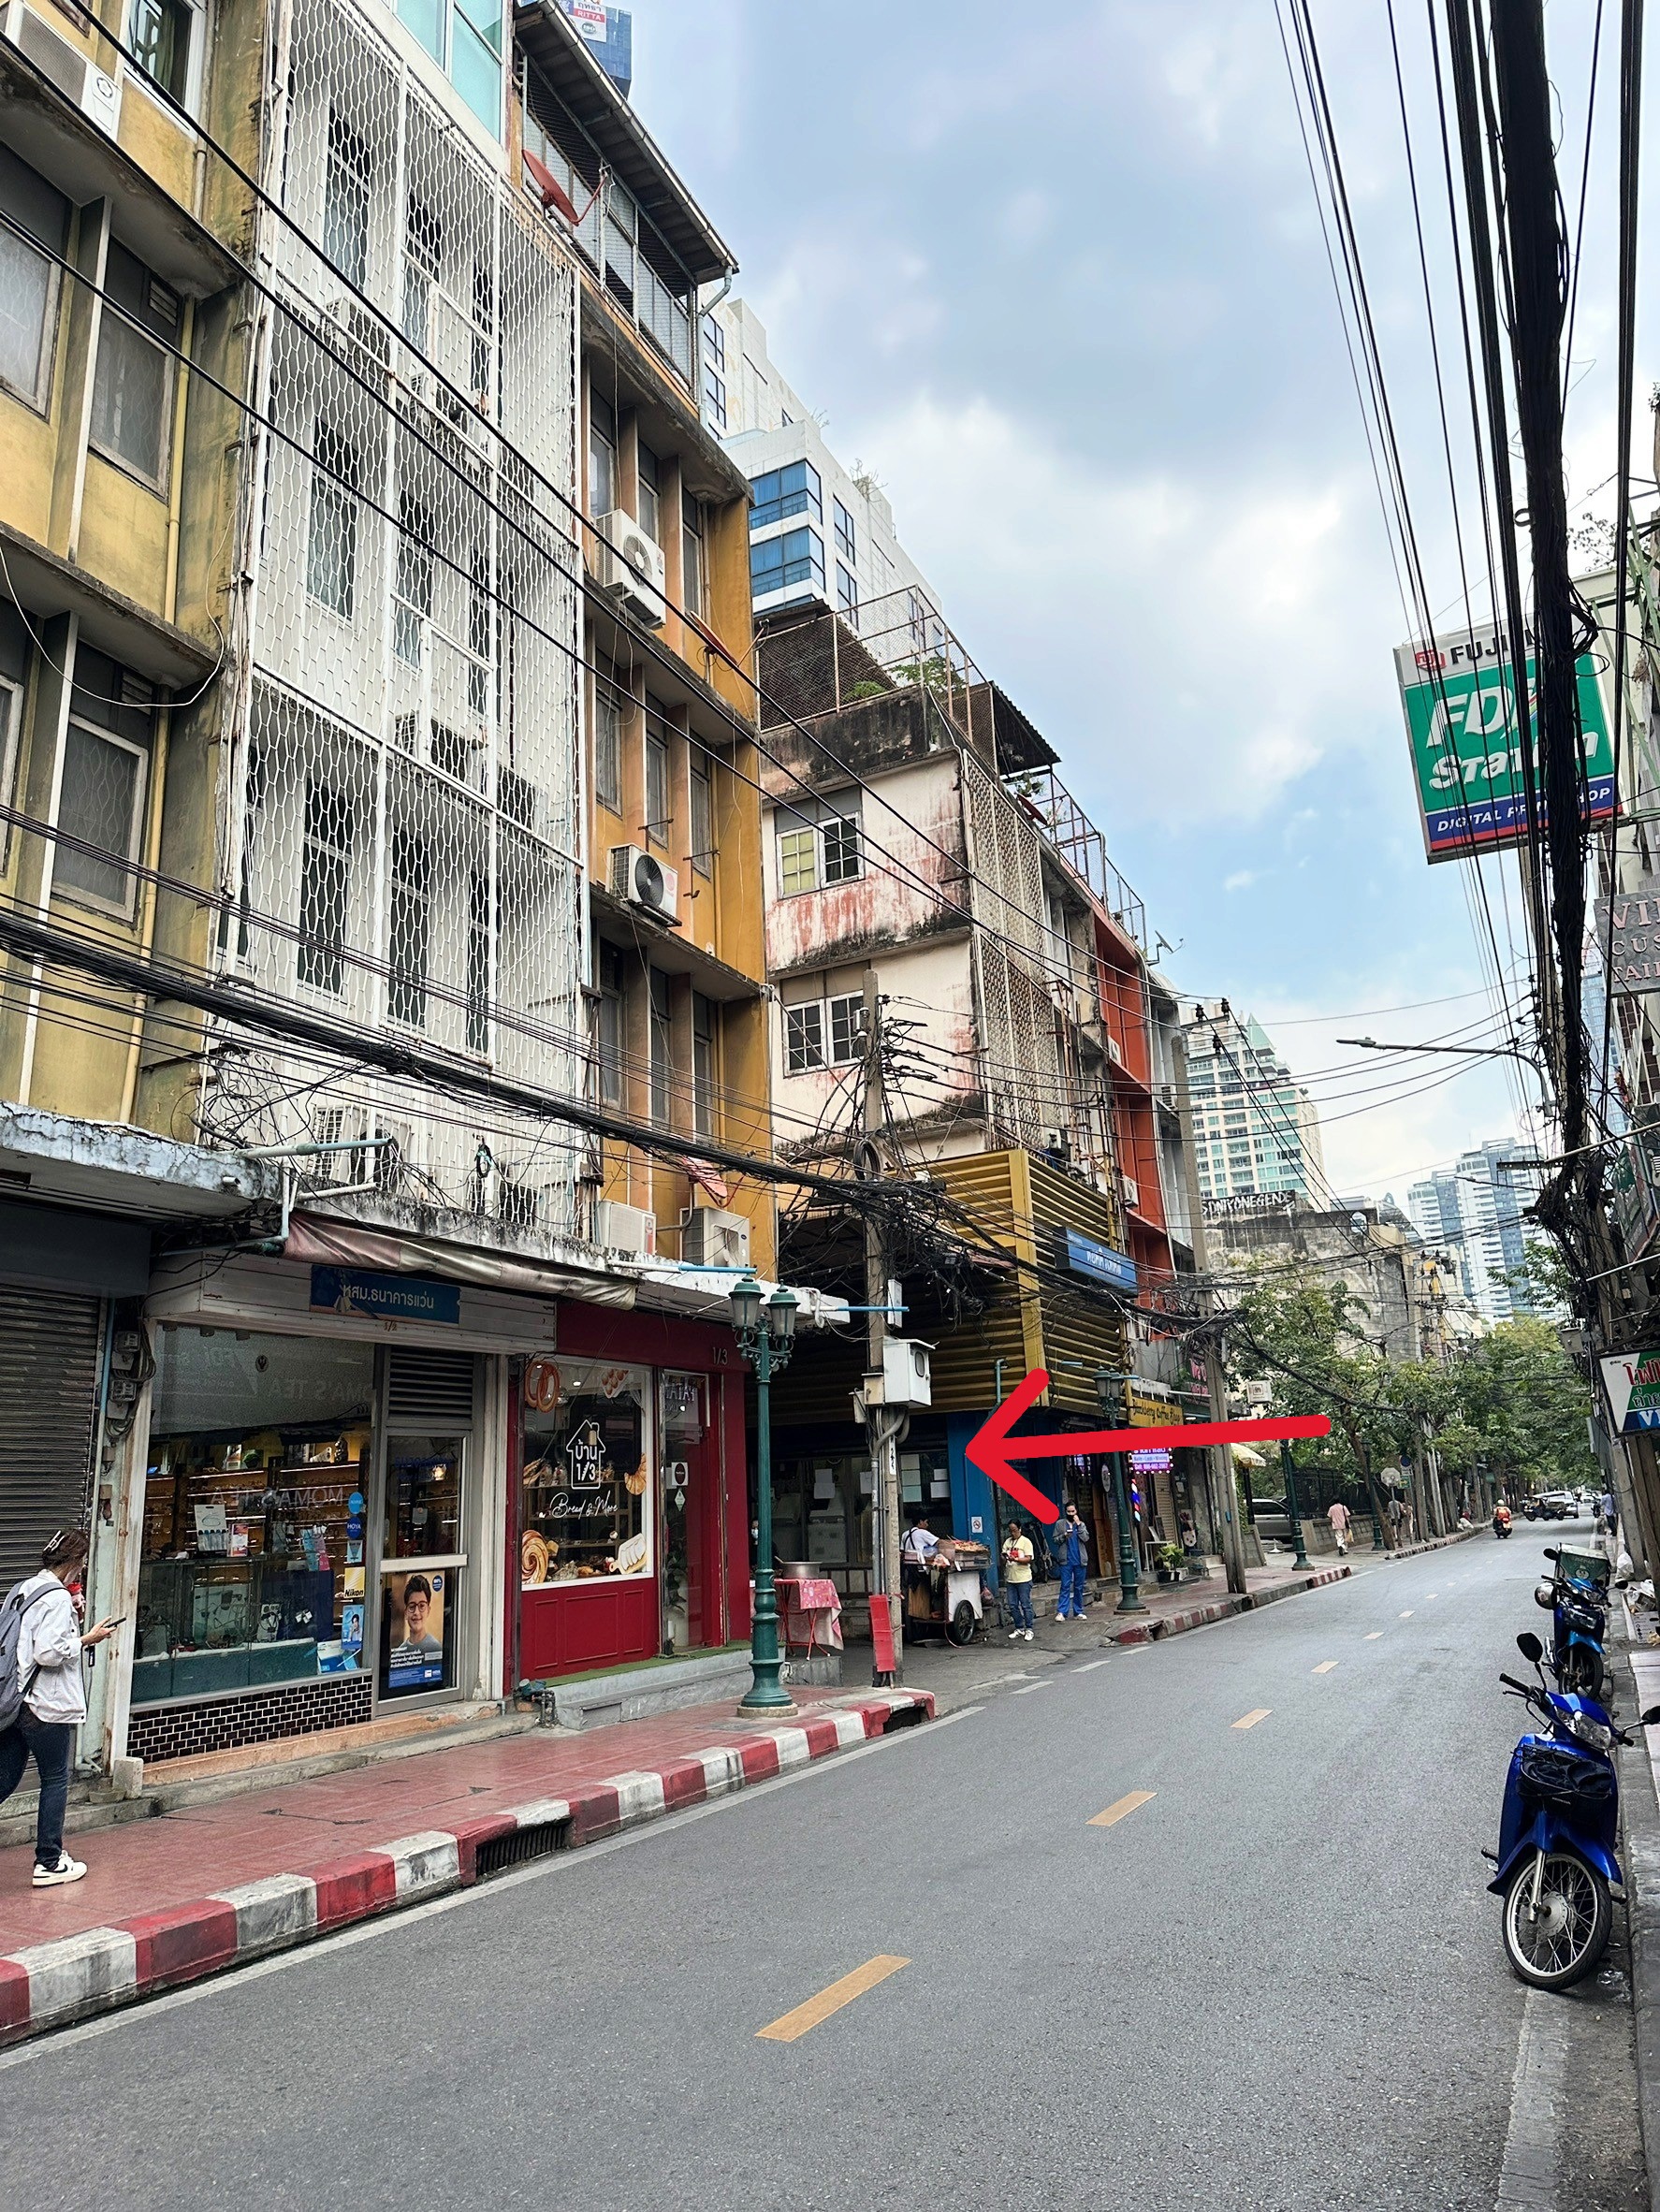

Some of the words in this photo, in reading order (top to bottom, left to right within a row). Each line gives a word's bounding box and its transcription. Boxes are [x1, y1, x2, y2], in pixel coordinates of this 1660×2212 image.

[577, 10, 602, 21] RITTA
[1437, 808, 1502, 833] DIGITAL
[342, 1283, 434, 1309] หสม.ธนาคารแว่น
[712, 1346, 728, 1366] 1/3
[575, 1438, 598, 1461] บ้าน
[575, 1461, 596, 1481] 1/3
[549, 1492, 587, 1520] Bread
[594, 1490, 619, 1517] More
[344, 1589, 364, 1597] Nikon
